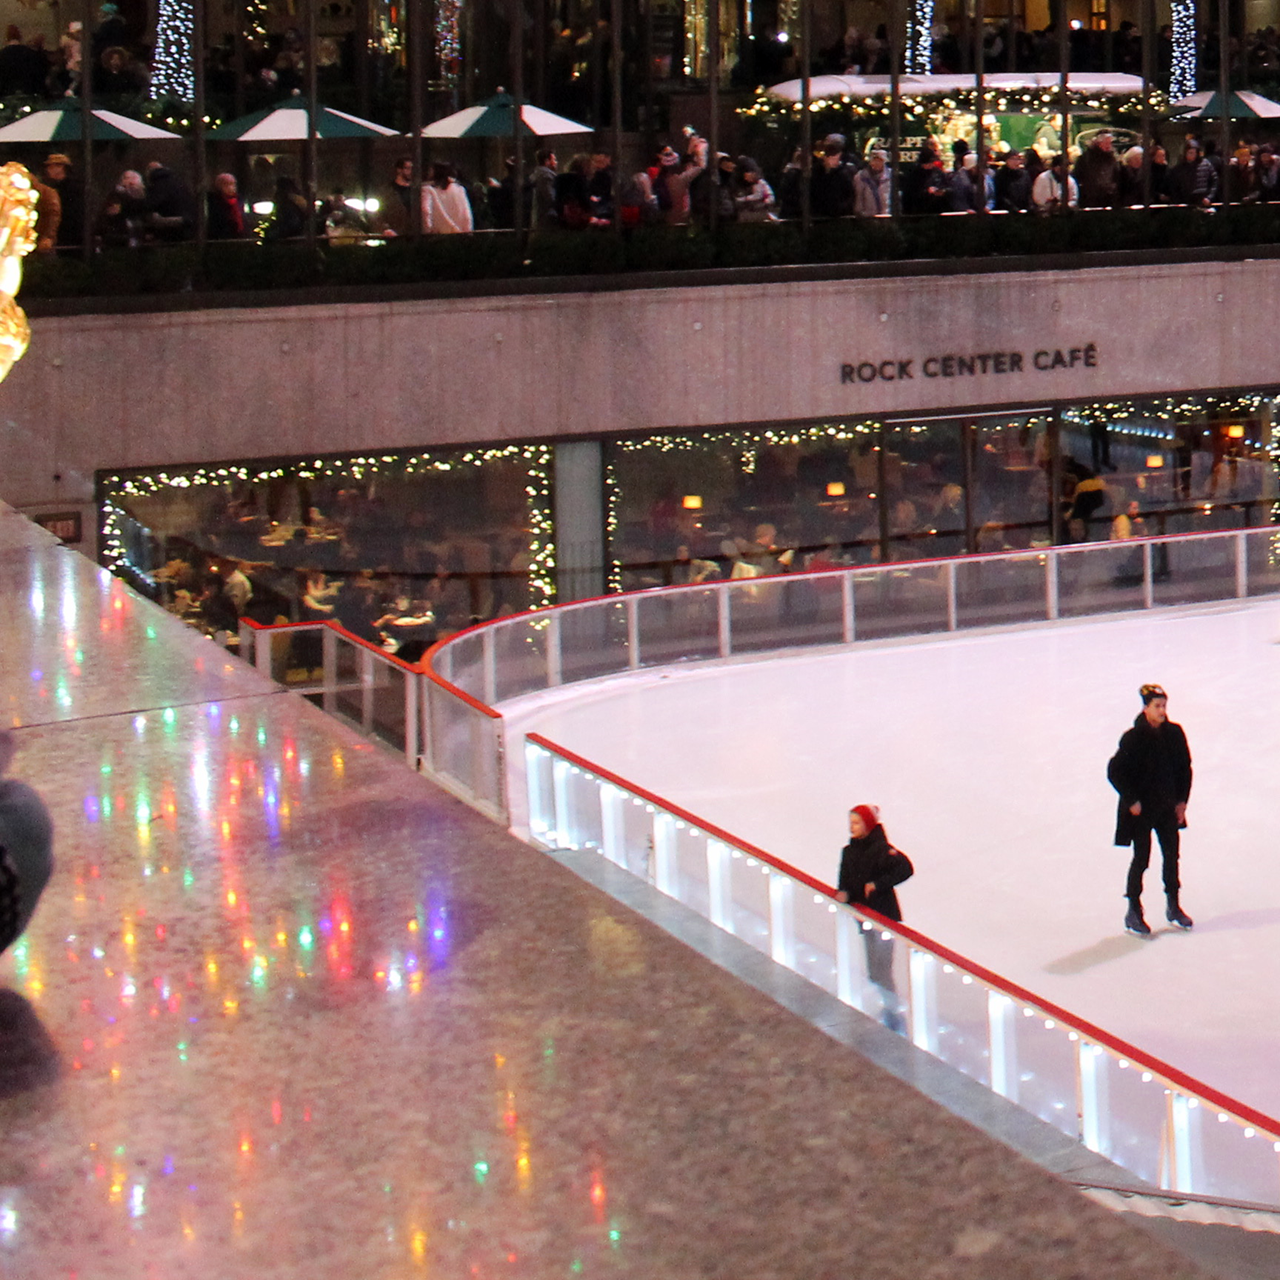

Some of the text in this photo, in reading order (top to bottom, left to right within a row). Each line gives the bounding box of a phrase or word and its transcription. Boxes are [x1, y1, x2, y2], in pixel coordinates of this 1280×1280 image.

[841, 343, 1097, 384] ROCK CENTER CAFÉ
